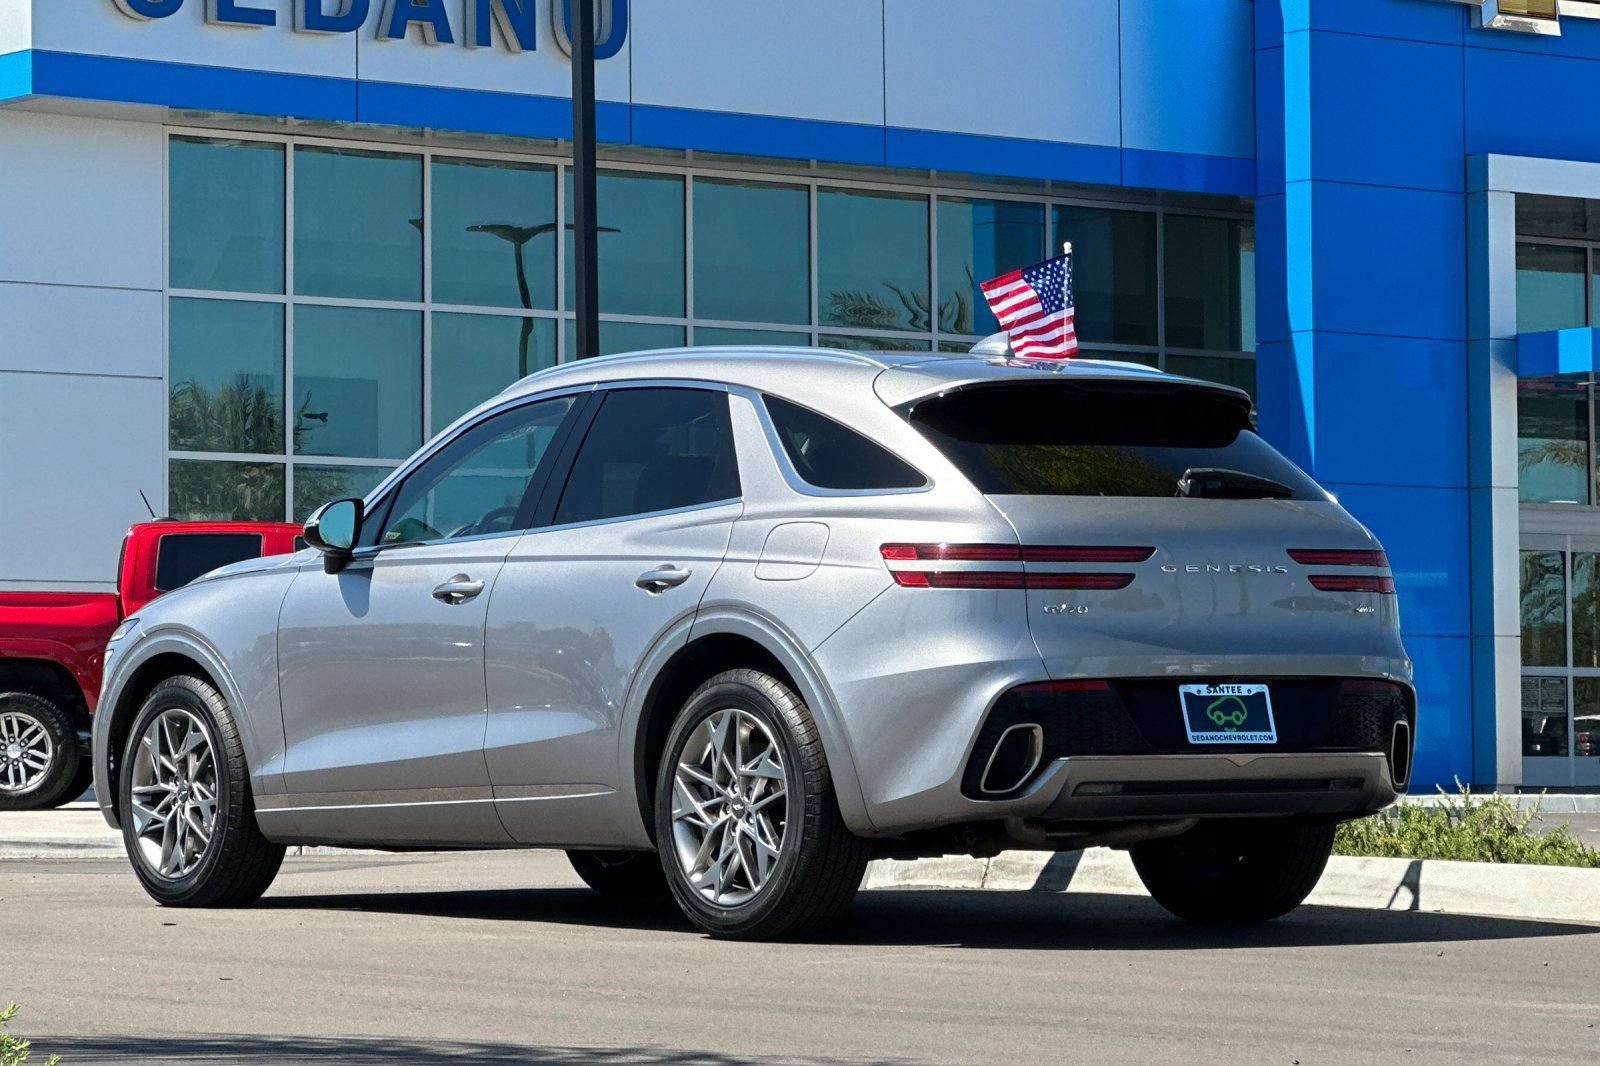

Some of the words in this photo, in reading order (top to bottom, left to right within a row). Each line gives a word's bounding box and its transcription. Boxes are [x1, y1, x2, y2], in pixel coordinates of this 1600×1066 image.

[1160, 564, 1288, 573] GENESIS
[1206, 685, 1243, 694] SANTEE
[1191, 734, 1274, 742] SEDANOCHEVROLET.COM
